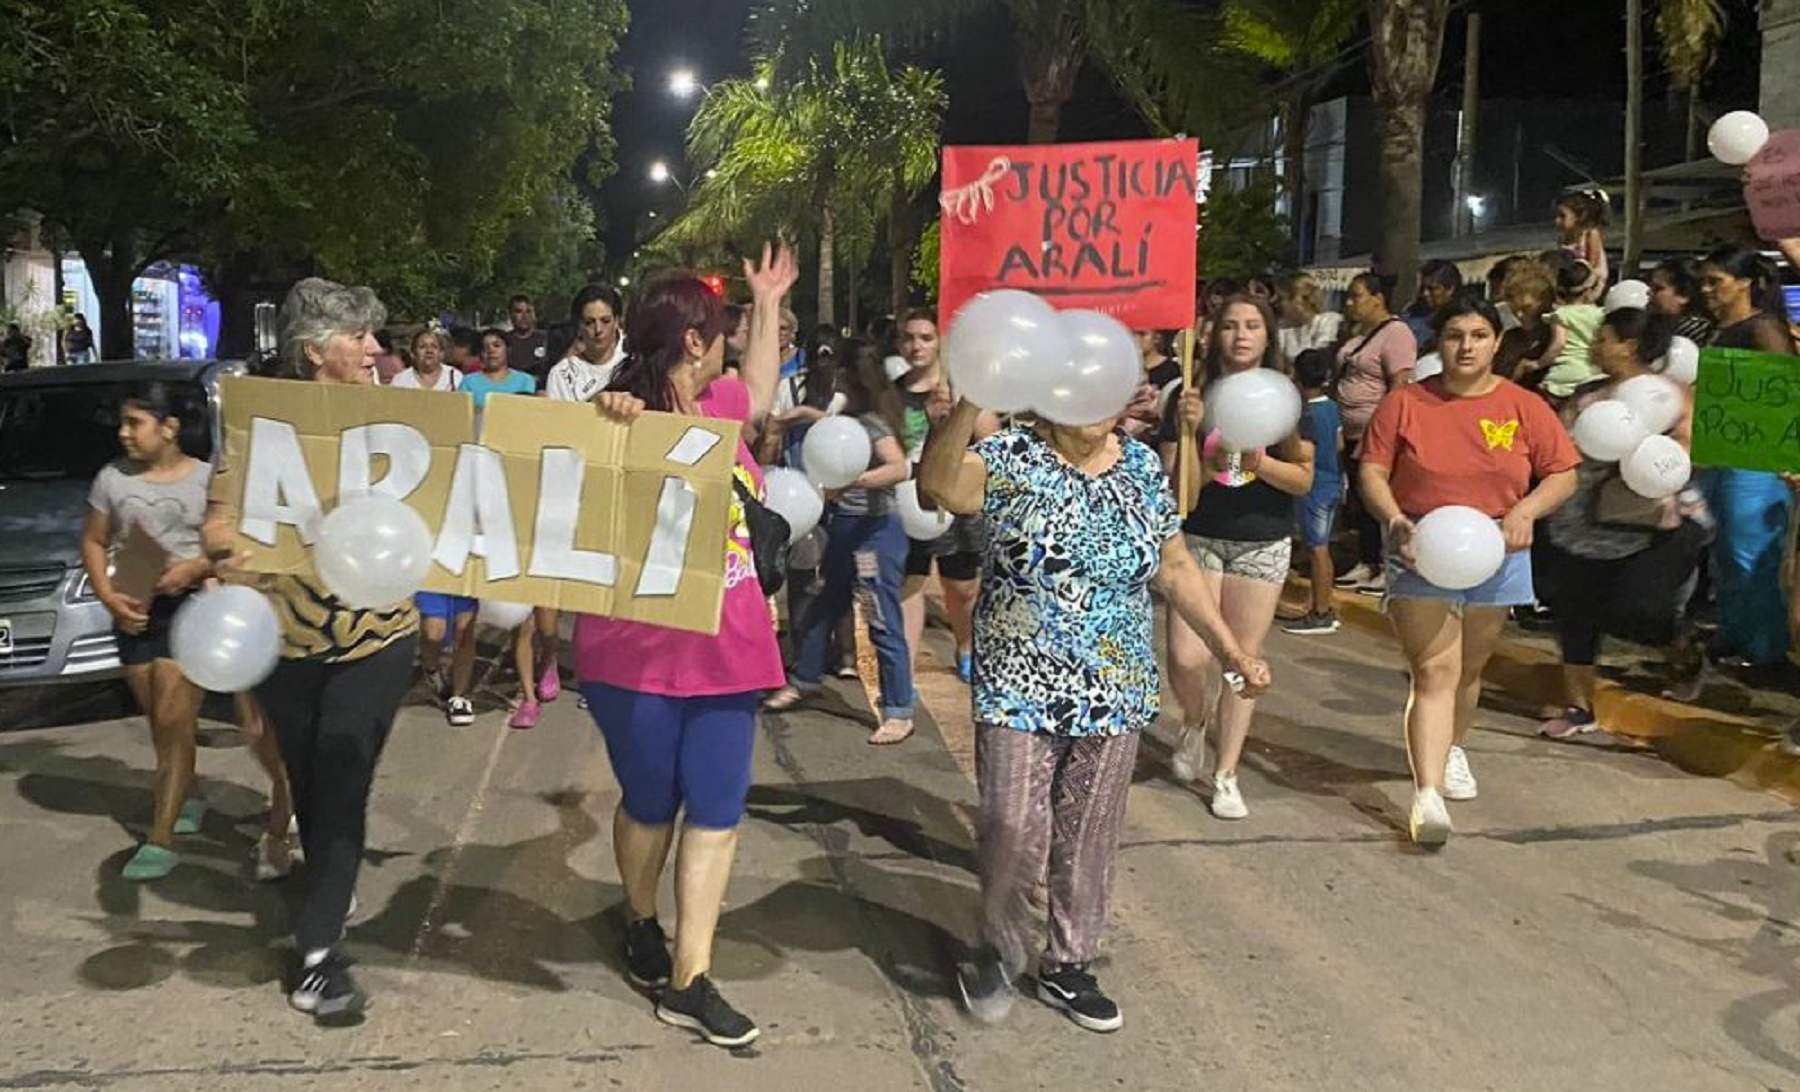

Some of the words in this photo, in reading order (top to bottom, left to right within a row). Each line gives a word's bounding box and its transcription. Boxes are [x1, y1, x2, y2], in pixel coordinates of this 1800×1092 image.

[1005, 153, 1196, 202] JUSTICIA
[1041, 201, 1122, 244] POR
[995, 221, 1153, 281] ARALÍ
